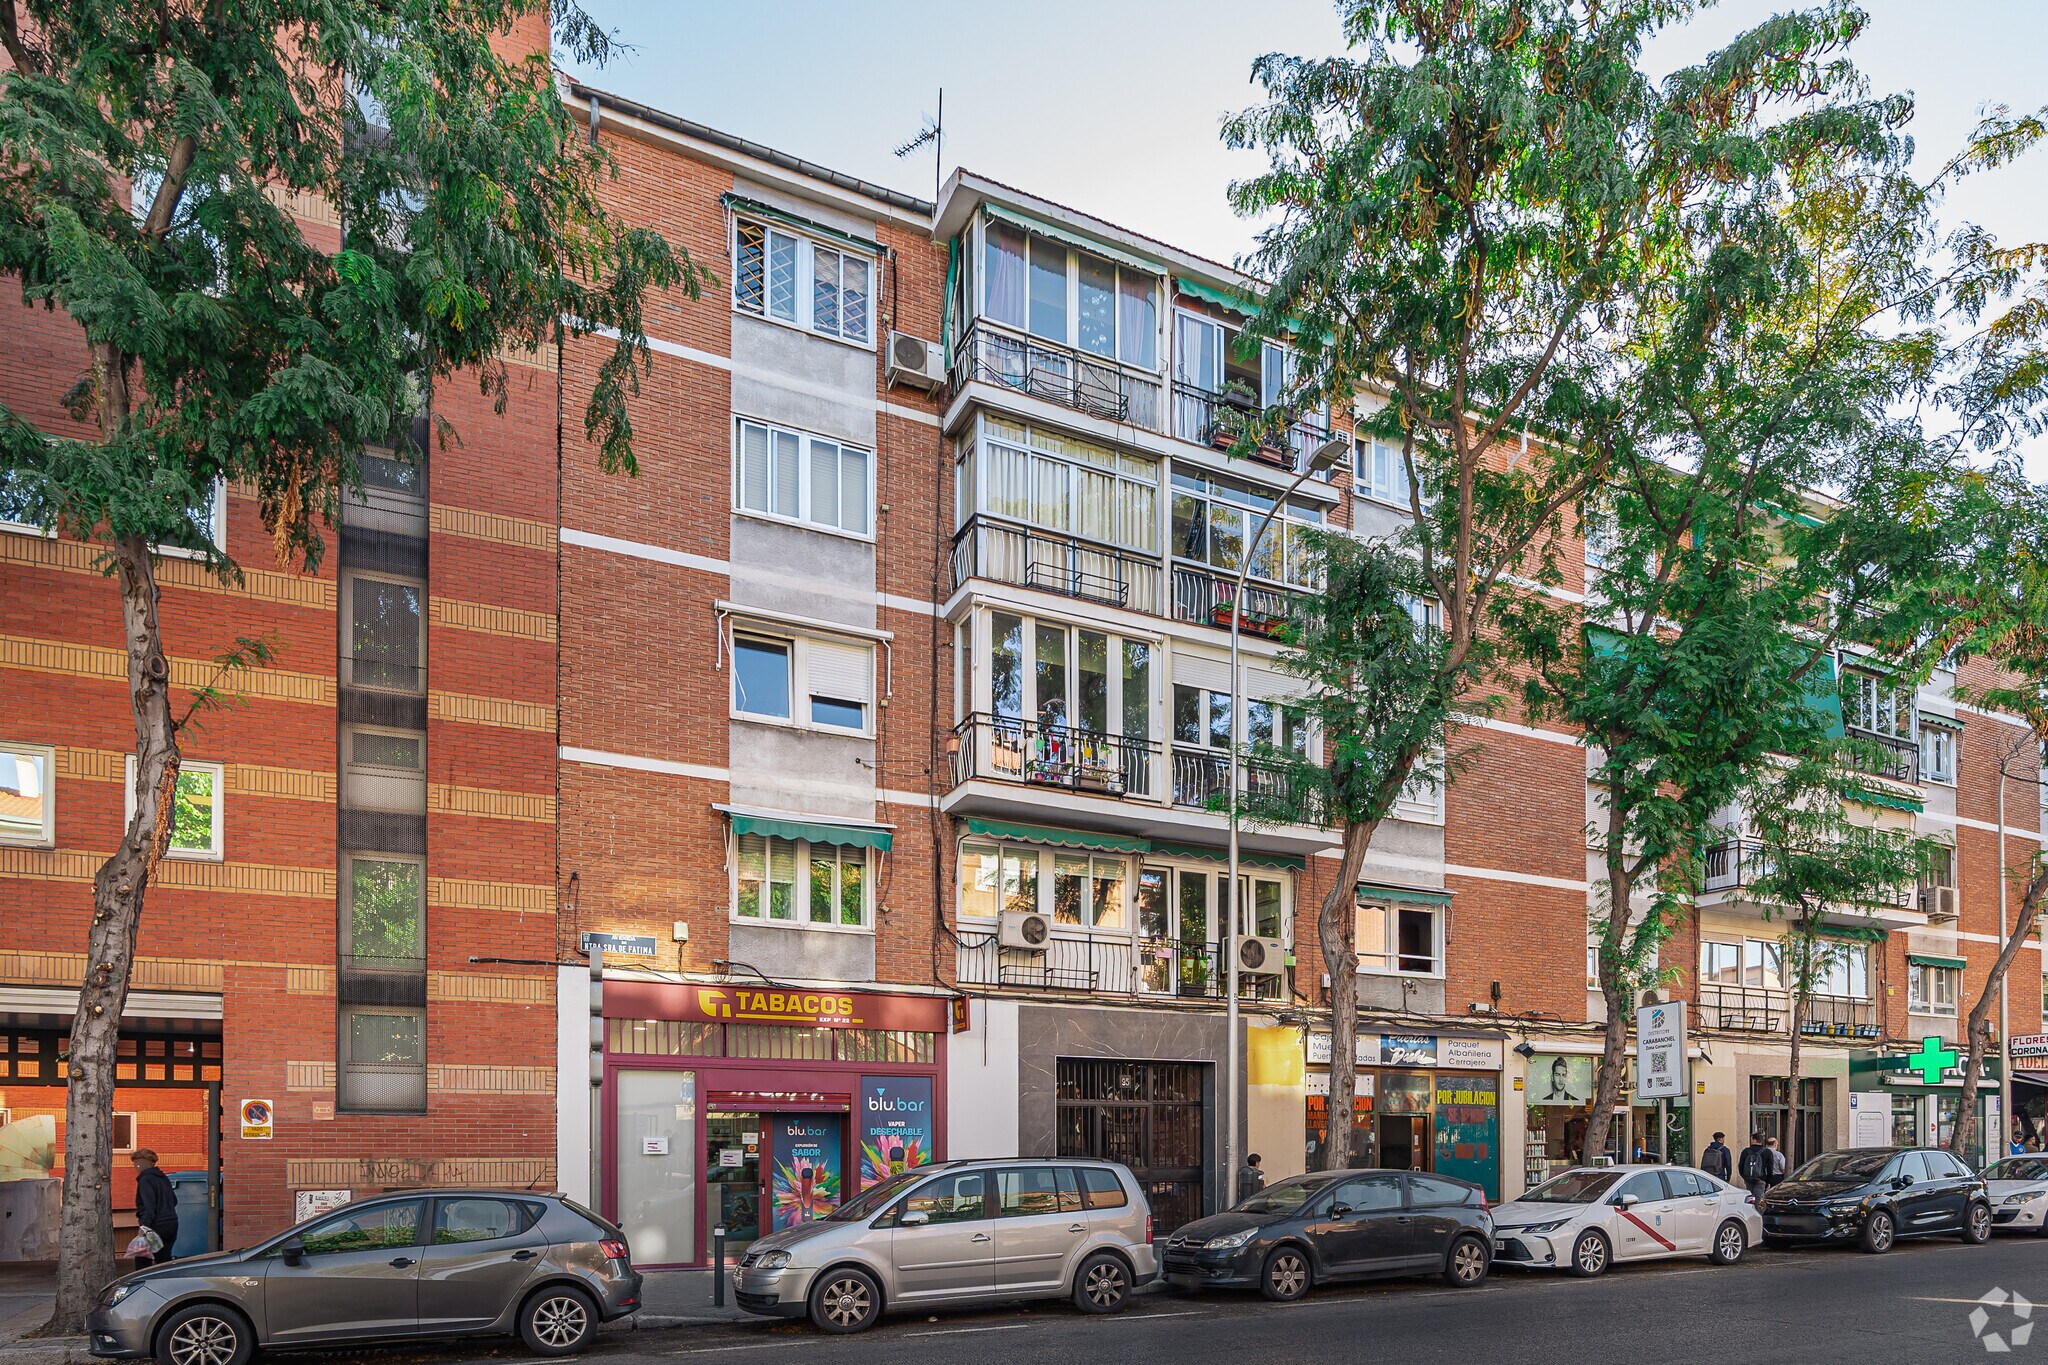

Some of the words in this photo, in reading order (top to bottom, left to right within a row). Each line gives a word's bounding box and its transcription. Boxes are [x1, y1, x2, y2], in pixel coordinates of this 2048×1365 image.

[619, 944, 627, 952] DE
[736, 991, 853, 1015] TABACOS
[1447, 1040, 1480, 1050] Parquet
[1642, 1036, 1676, 1045] CARABANCHEL
[1448, 1058, 1486, 1066] Cerrajero
[1437, 1089, 1453, 1105] POR
[1454, 1090, 1496, 1106] JUBILACION
[868, 1096, 925, 1111] blu.bar
[1308, 1095, 1325, 1111] POR
[787, 1125, 827, 1136] blu.bar
[870, 1127, 922, 1136] DESECHABLE
[791, 1148, 821, 1157] SABOR
